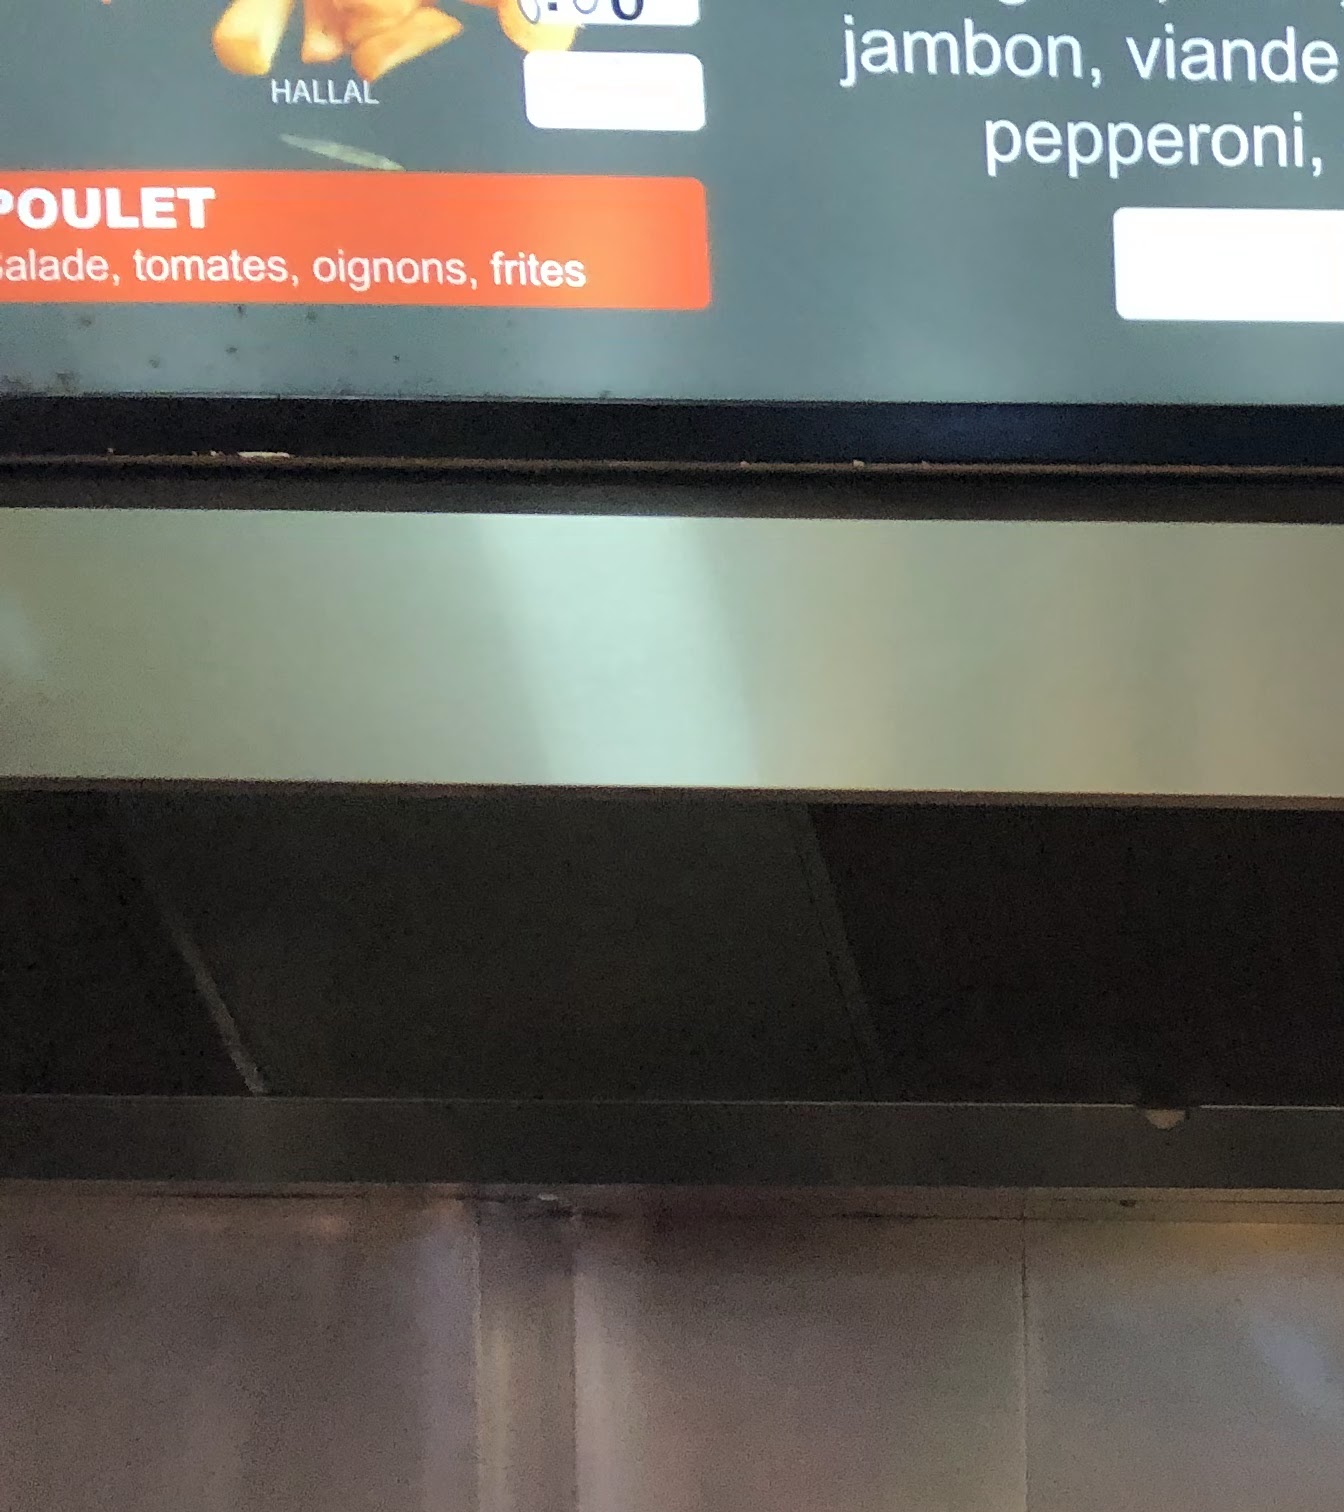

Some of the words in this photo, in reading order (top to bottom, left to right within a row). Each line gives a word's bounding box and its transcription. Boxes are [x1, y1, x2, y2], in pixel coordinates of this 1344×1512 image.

[839, 14, 1101, 87] jambon,
[1126, 23, 1339, 84] viande
[271, 78, 380, 105] HALLAL
[985, 111, 1322, 179] pepperoni,
[0, 248, 120, 285] alade,
[132, 249, 298, 286] tomates,
[313, 250, 478, 292] oignons,
[490, 250, 587, 288] frites
